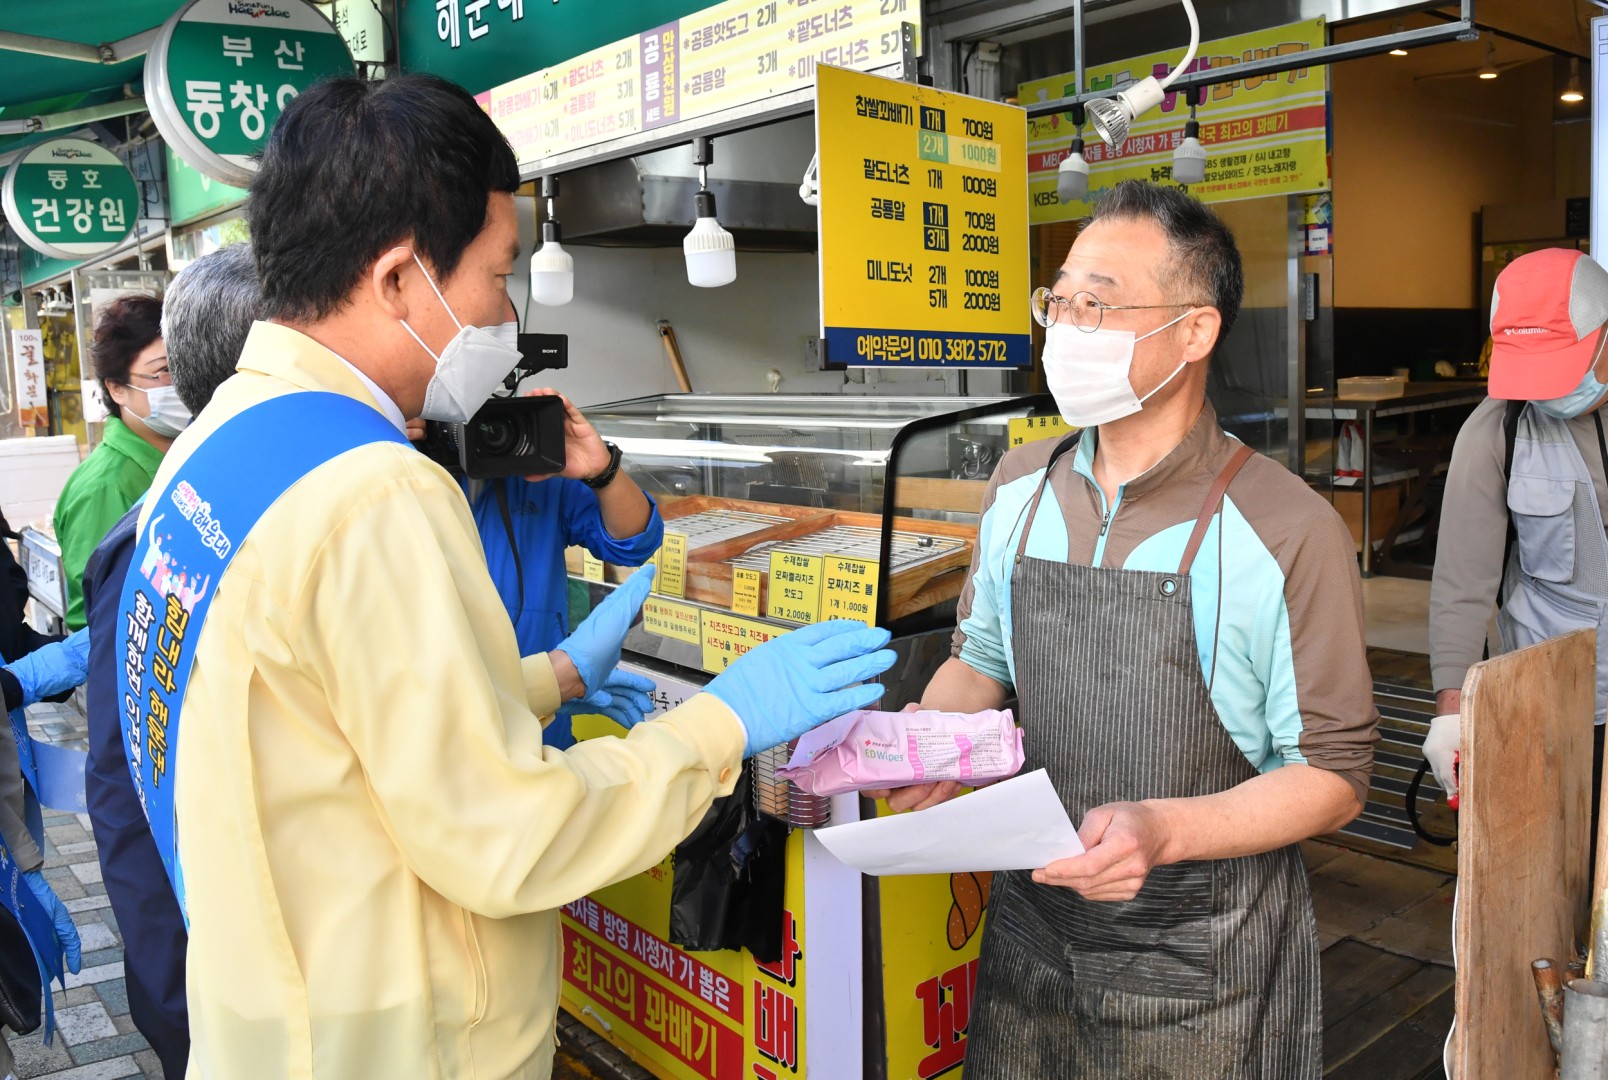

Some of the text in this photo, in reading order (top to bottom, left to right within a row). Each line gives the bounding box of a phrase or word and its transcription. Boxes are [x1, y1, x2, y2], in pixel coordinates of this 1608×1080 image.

[690, 2, 778, 52] 공룡핫도그 2개
[796, 5, 854, 43] 팥도너츠
[615, 48, 633, 71] 2개
[690, 50, 779, 96] 공룡알 3개
[543, 81, 559, 101] 4개
[617, 79, 634, 100] 3개
[185, 79, 299, 141] 동창
[618, 109, 635, 129] 5개
[855, 95, 994, 141] 찹쌀꽈배기 1개 700원
[923, 134, 997, 165] 2개 1000원
[1042, 151, 1064, 168] MBC
[1126, 136, 1156, 154] 시청자
[1158, 132, 1169, 149] 가
[1220, 119, 1254, 141] 최고의
[1256, 112, 1289, 134] 꽈배기
[1219, 154, 1247, 167] 생활경제
[1255, 151, 1267, 163] 6시
[1268, 148, 1291, 160] 내고향
[863, 159, 997, 198] 팥도너츠 1개 1000원
[1198, 165, 1245, 184] 발모닝와이드
[1253, 161, 1297, 176] 전국노래자랑
[1033, 191, 1059, 207] KBS
[31, 197, 126, 234] 건강원
[870, 197, 996, 232] 공룡알 1개 700원
[927, 229, 999, 255] 3개 2000원
[866, 259, 999, 289] 미니도넛 2개 1000원
[929, 288, 1000, 312] 5개 2000원
[856, 334, 1007, 362] 예약문의 010 3812 5712
[193, 503, 231, 558] 해운대
[783, 555, 810, 568] 수제찹쌀
[837, 561, 866, 575] 수제찹쌀
[784, 588, 804, 600] 핫도그
[827, 577, 860, 593] 모짜치즈
[773, 606, 812, 622] 1개 2,000원
[829, 599, 869, 614] 1개 1,000원
[709, 620, 747, 638] 치즈핫도그와
[125, 590, 155, 699] 함께하면
[706, 636, 731, 652] 시즈닝을
[147, 594, 189, 788] 힘내라 해운대!
[603, 909, 630, 950] 방영
[632, 929, 675, 979] 시청자
[679, 954, 695, 991] 가
[698, 965, 730, 1012] 뽑은
[572, 937, 636, 1022] 최고의
[643, 982, 718, 1071] 꽈배기
